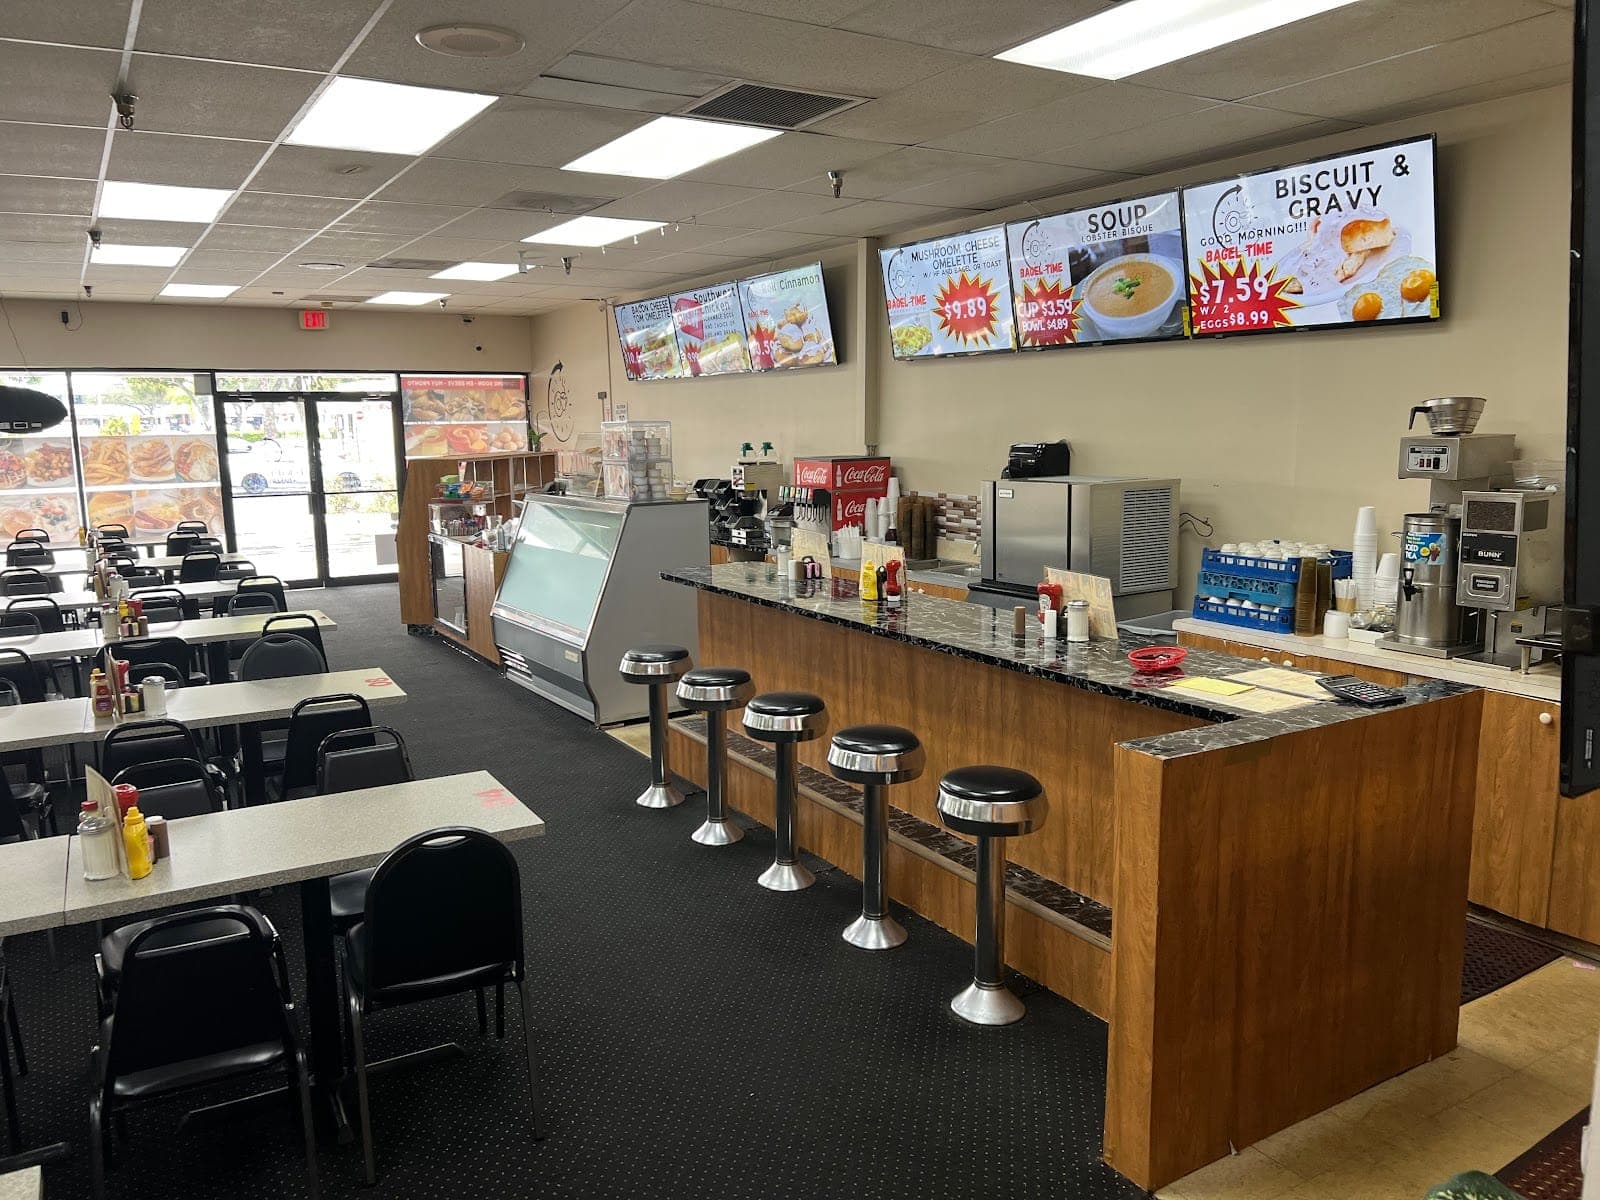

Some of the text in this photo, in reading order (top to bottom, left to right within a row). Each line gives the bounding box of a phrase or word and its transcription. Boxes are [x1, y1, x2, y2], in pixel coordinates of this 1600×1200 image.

[1275, 153, 1410, 199] BISCUIT &
[1288, 184, 1382, 220] GRAVY
[1087, 204, 1147, 233] SOUP
[1081, 224, 1153, 243] LOBSTER BISQUE
[1200, 221, 1307, 247] GOOD MORNING!!!
[912, 236, 1000, 262] MUSHROOM CHEESE
[932, 253, 978, 270] OMELETTE
[983, 260, 1001, 269] TOAST
[779, 274, 820, 291] Cinnamon
[1200, 277, 1269, 304] $7.59
[631, 299, 669, 315] BACON CHEESE
[633, 309, 671, 323] TOM OMELETTE
[944, 296, 988, 321] $9.89
[1018, 299, 1073, 318] CUP $3.59
[1223, 304, 1230, 314] 2
[304, 311, 326, 328] EXIT
[1022, 321, 1046, 332] BOWL
[1200, 310, 1269, 330] EGGS $8.99
[801, 466, 828, 484] Coca-Cola
[844, 465, 886, 484] Coca-Cola
[1478, 550, 1501, 559] BUNN
